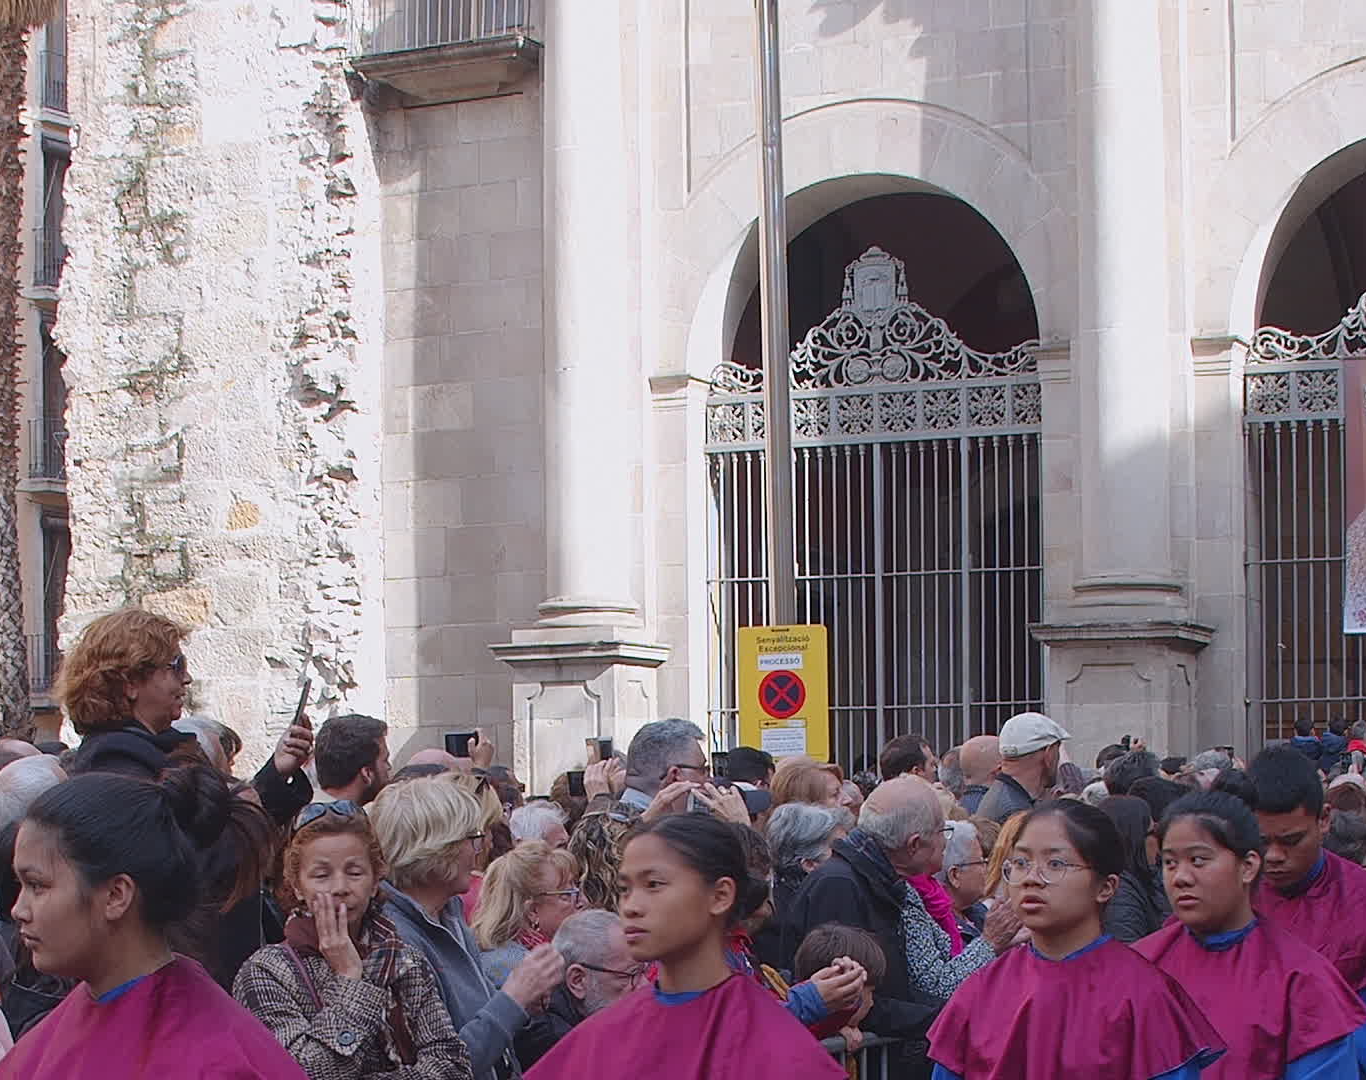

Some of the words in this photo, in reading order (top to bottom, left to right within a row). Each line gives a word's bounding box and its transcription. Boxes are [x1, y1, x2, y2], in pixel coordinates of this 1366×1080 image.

[756, 633, 810, 645] Senyalització
[758, 643, 808, 653] Excepcional
[760, 656, 800, 665] PROCESSÓ
